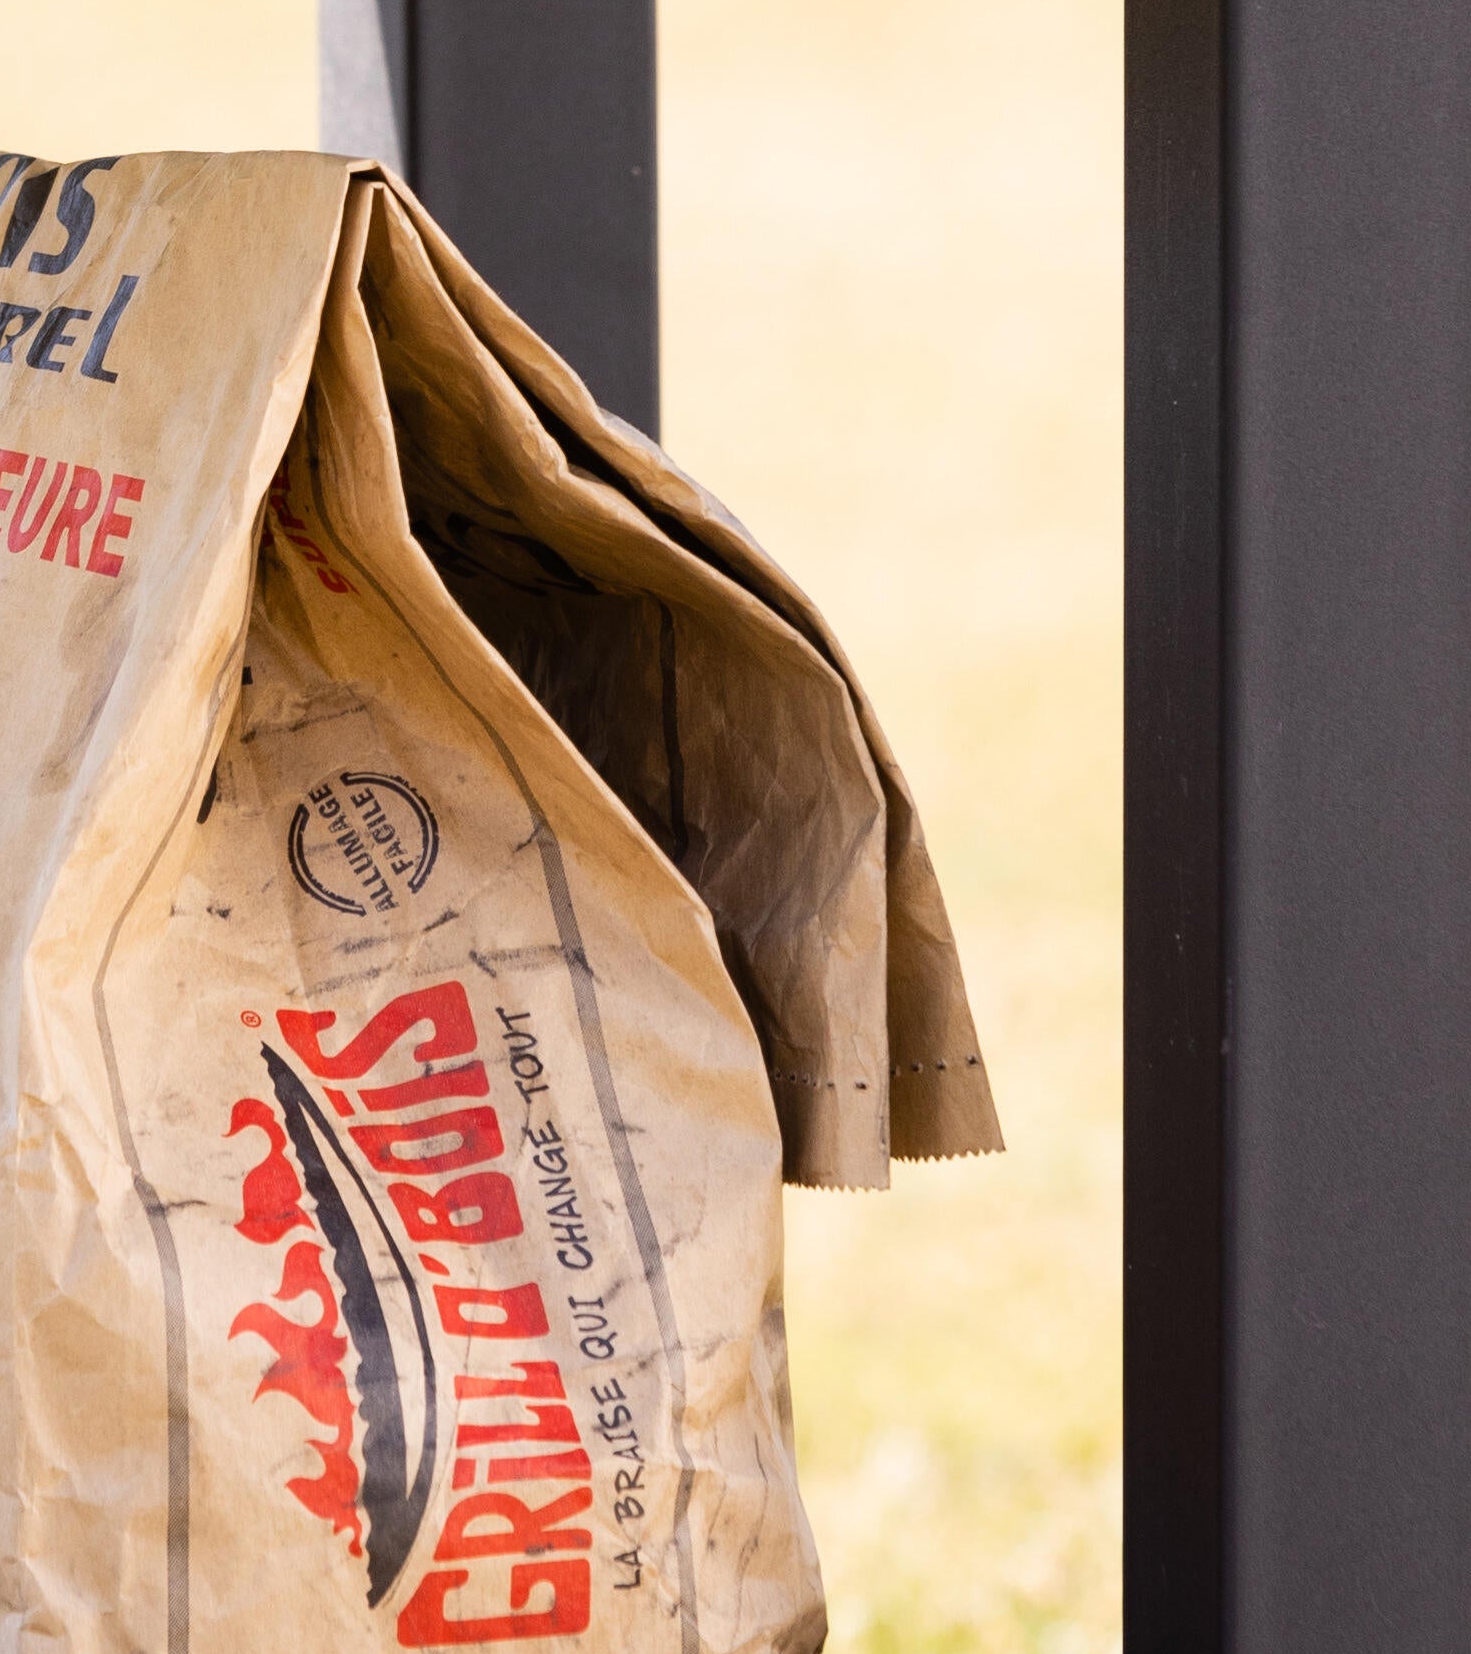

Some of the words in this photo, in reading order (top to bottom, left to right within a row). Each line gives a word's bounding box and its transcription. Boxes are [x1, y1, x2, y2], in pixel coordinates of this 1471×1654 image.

[308, 782, 400, 914] ALLUMAGE
[351, 786, 414, 877] FACILE
[502, 1007, 550, 1105] TOUT
[528, 1119, 593, 1271] CHANGE
[567, 1294, 617, 1361] QUI
[591, 1376, 646, 1526] BRAISE
[613, 1545, 643, 1591] LA
